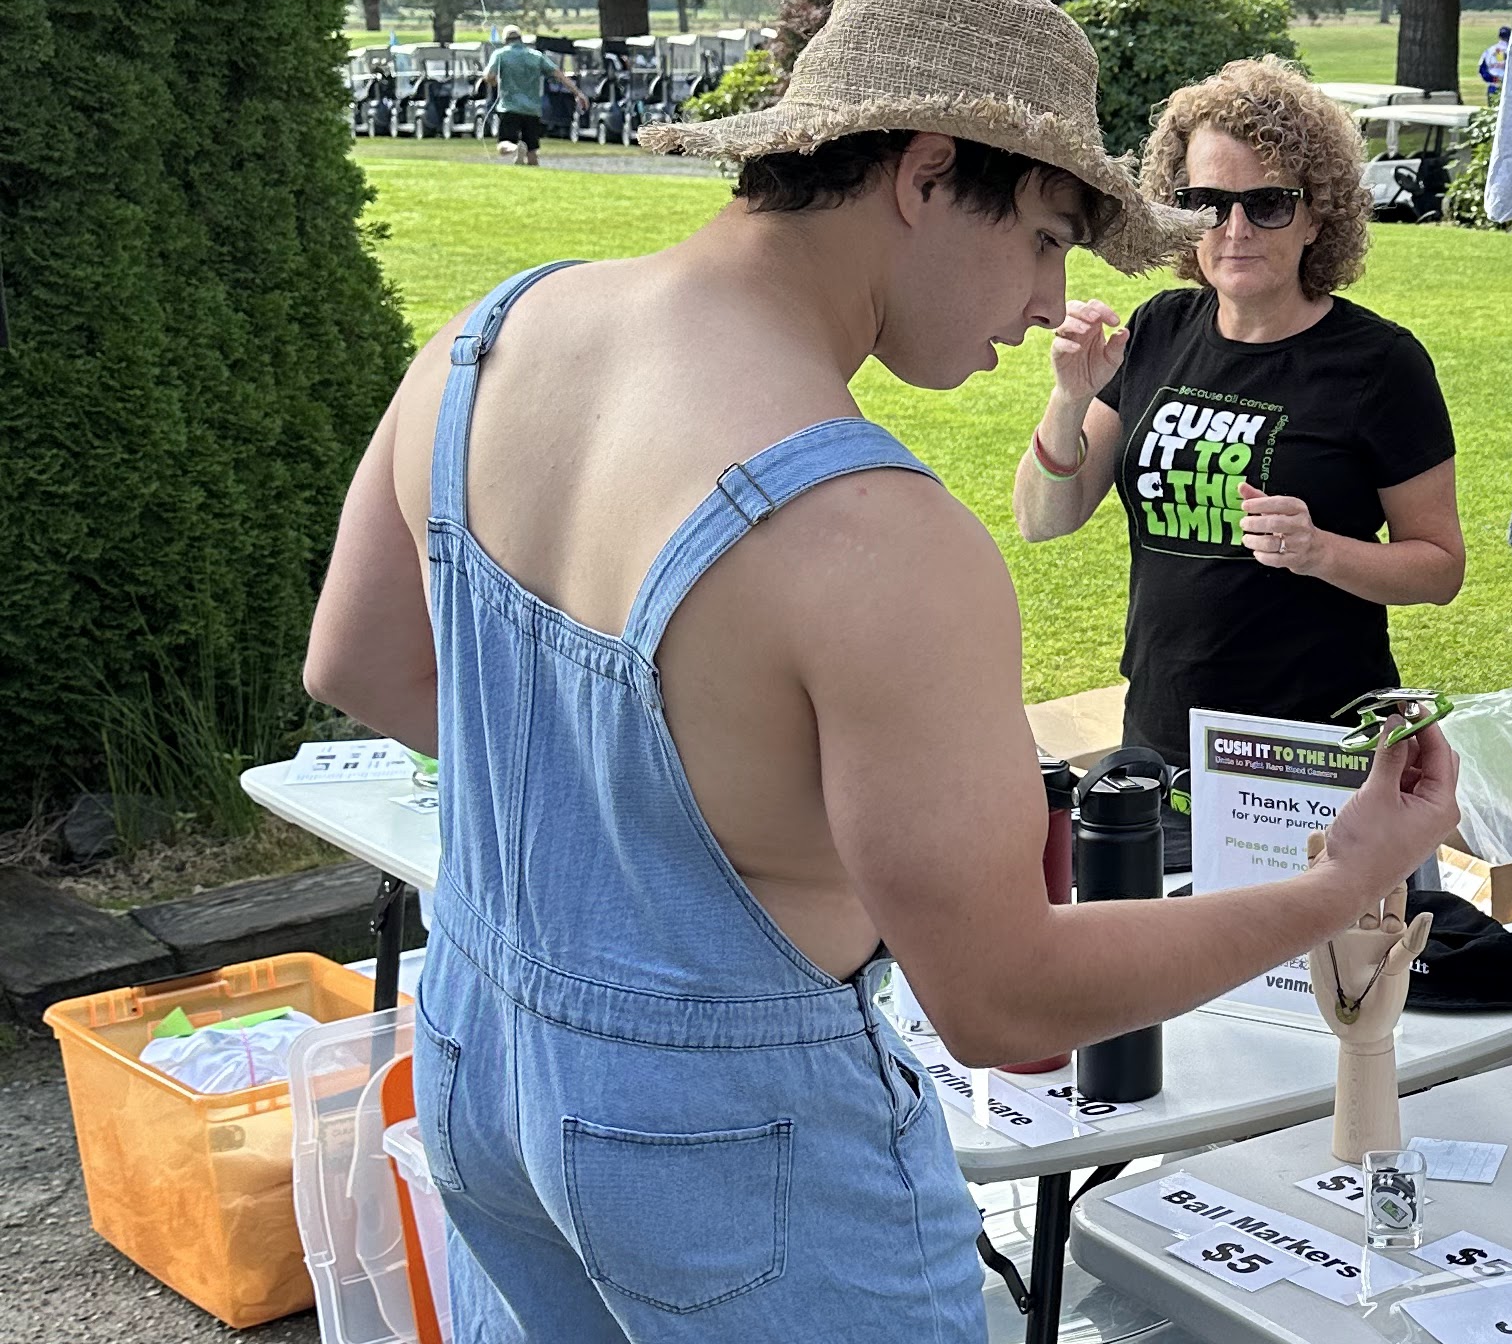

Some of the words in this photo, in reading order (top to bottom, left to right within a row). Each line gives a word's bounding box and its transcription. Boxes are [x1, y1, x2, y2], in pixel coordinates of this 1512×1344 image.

[1153, 401, 1266, 445] CUSH
[1138, 431, 1189, 470] IT
[1194, 439, 1252, 474] TO
[1167, 470, 1247, 510] THE
[1141, 501, 1250, 546] LIMIT
[1214, 738, 1253, 757] CUSH
[1255, 742, 1271, 758] IT
[1273, 746, 1294, 762] TO
[1296, 749, 1326, 766] THE
[1328, 752, 1369, 771] LIMIT
[1231, 808, 1250, 820] for
[1253, 811, 1282, 825] your
[1239, 790, 1301, 813] Thank
[1225, 836, 1269, 852] Please
[1272, 842, 1298, 856] add
[1267, 857, 1288, 869] the
[1162, 1189, 1235, 1221] Ball
[1230, 1215, 1362, 1279] Markers
[1201, 1242, 1274, 1275] $5
